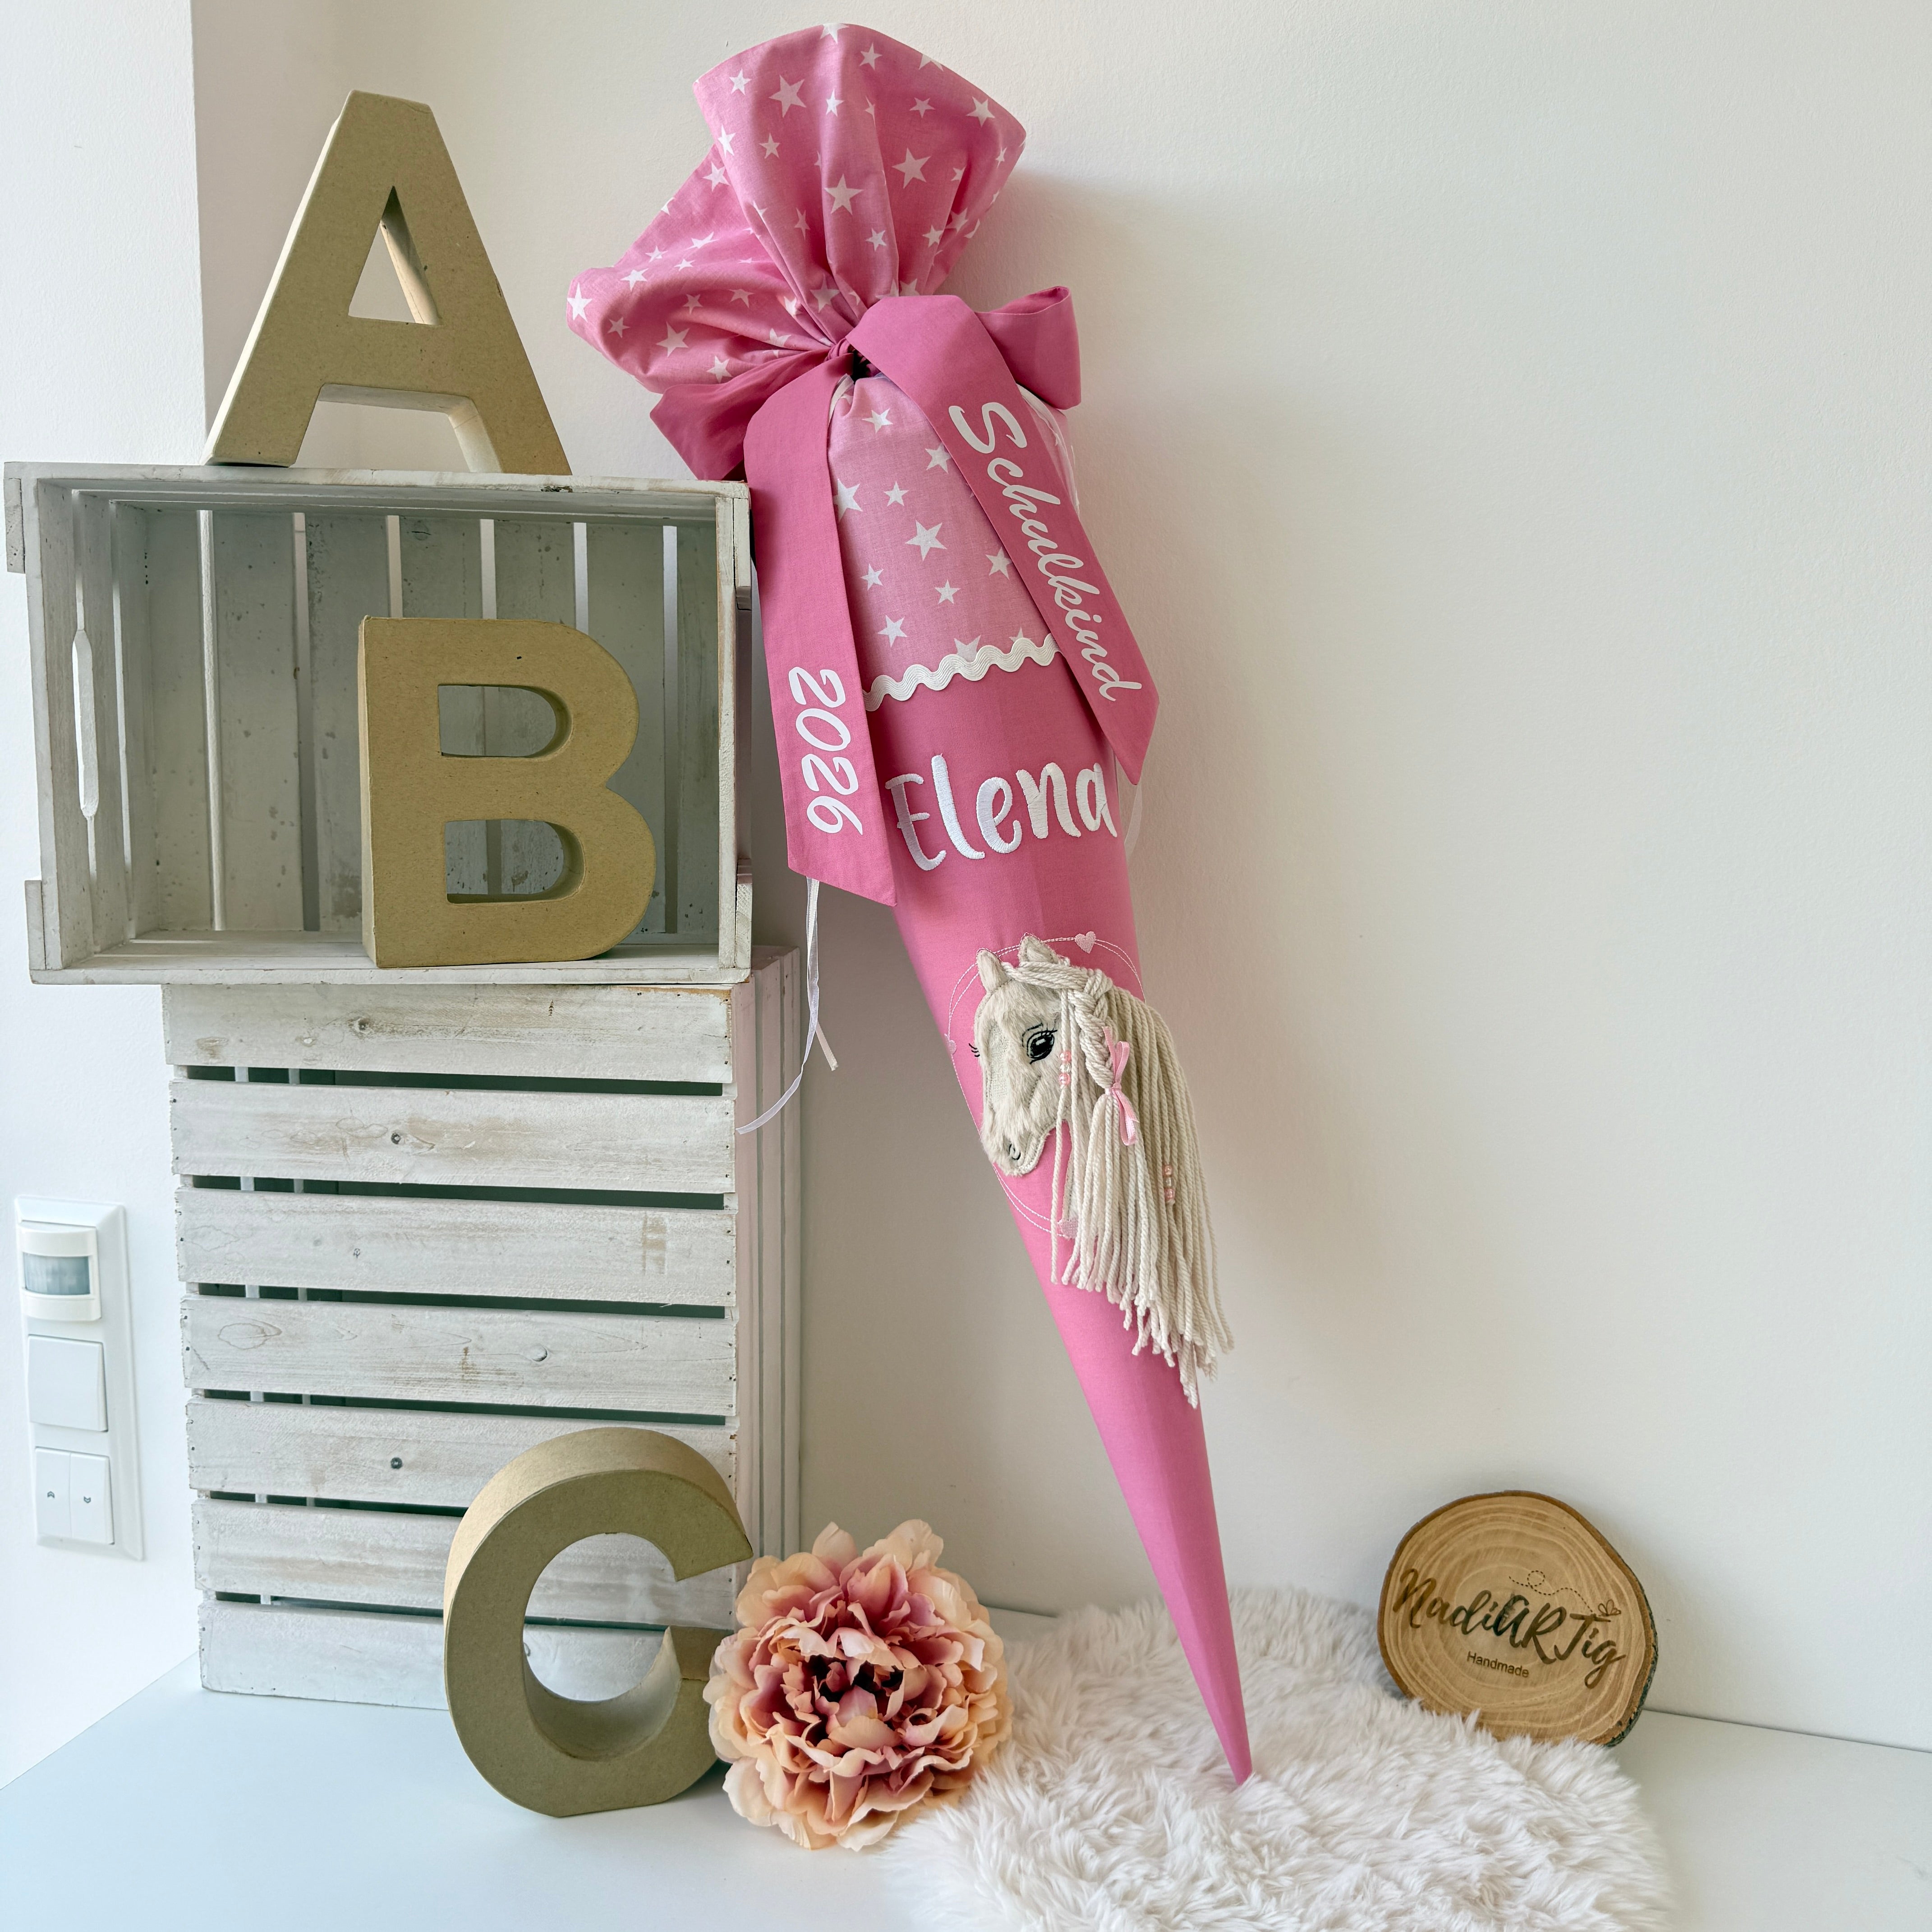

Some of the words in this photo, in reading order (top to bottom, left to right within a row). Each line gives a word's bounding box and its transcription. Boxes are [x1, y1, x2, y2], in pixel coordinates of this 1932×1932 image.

[203, 88, 573, 475] A
[949, 401, 1142, 702] Schulkind
[357, 615, 656, 969] B
[788, 666, 864, 836] 2026
[884, 753, 1118, 872] Elena
[443, 1426, 754, 1818] C
[1467, 1650, 1530, 1679] Handmade
